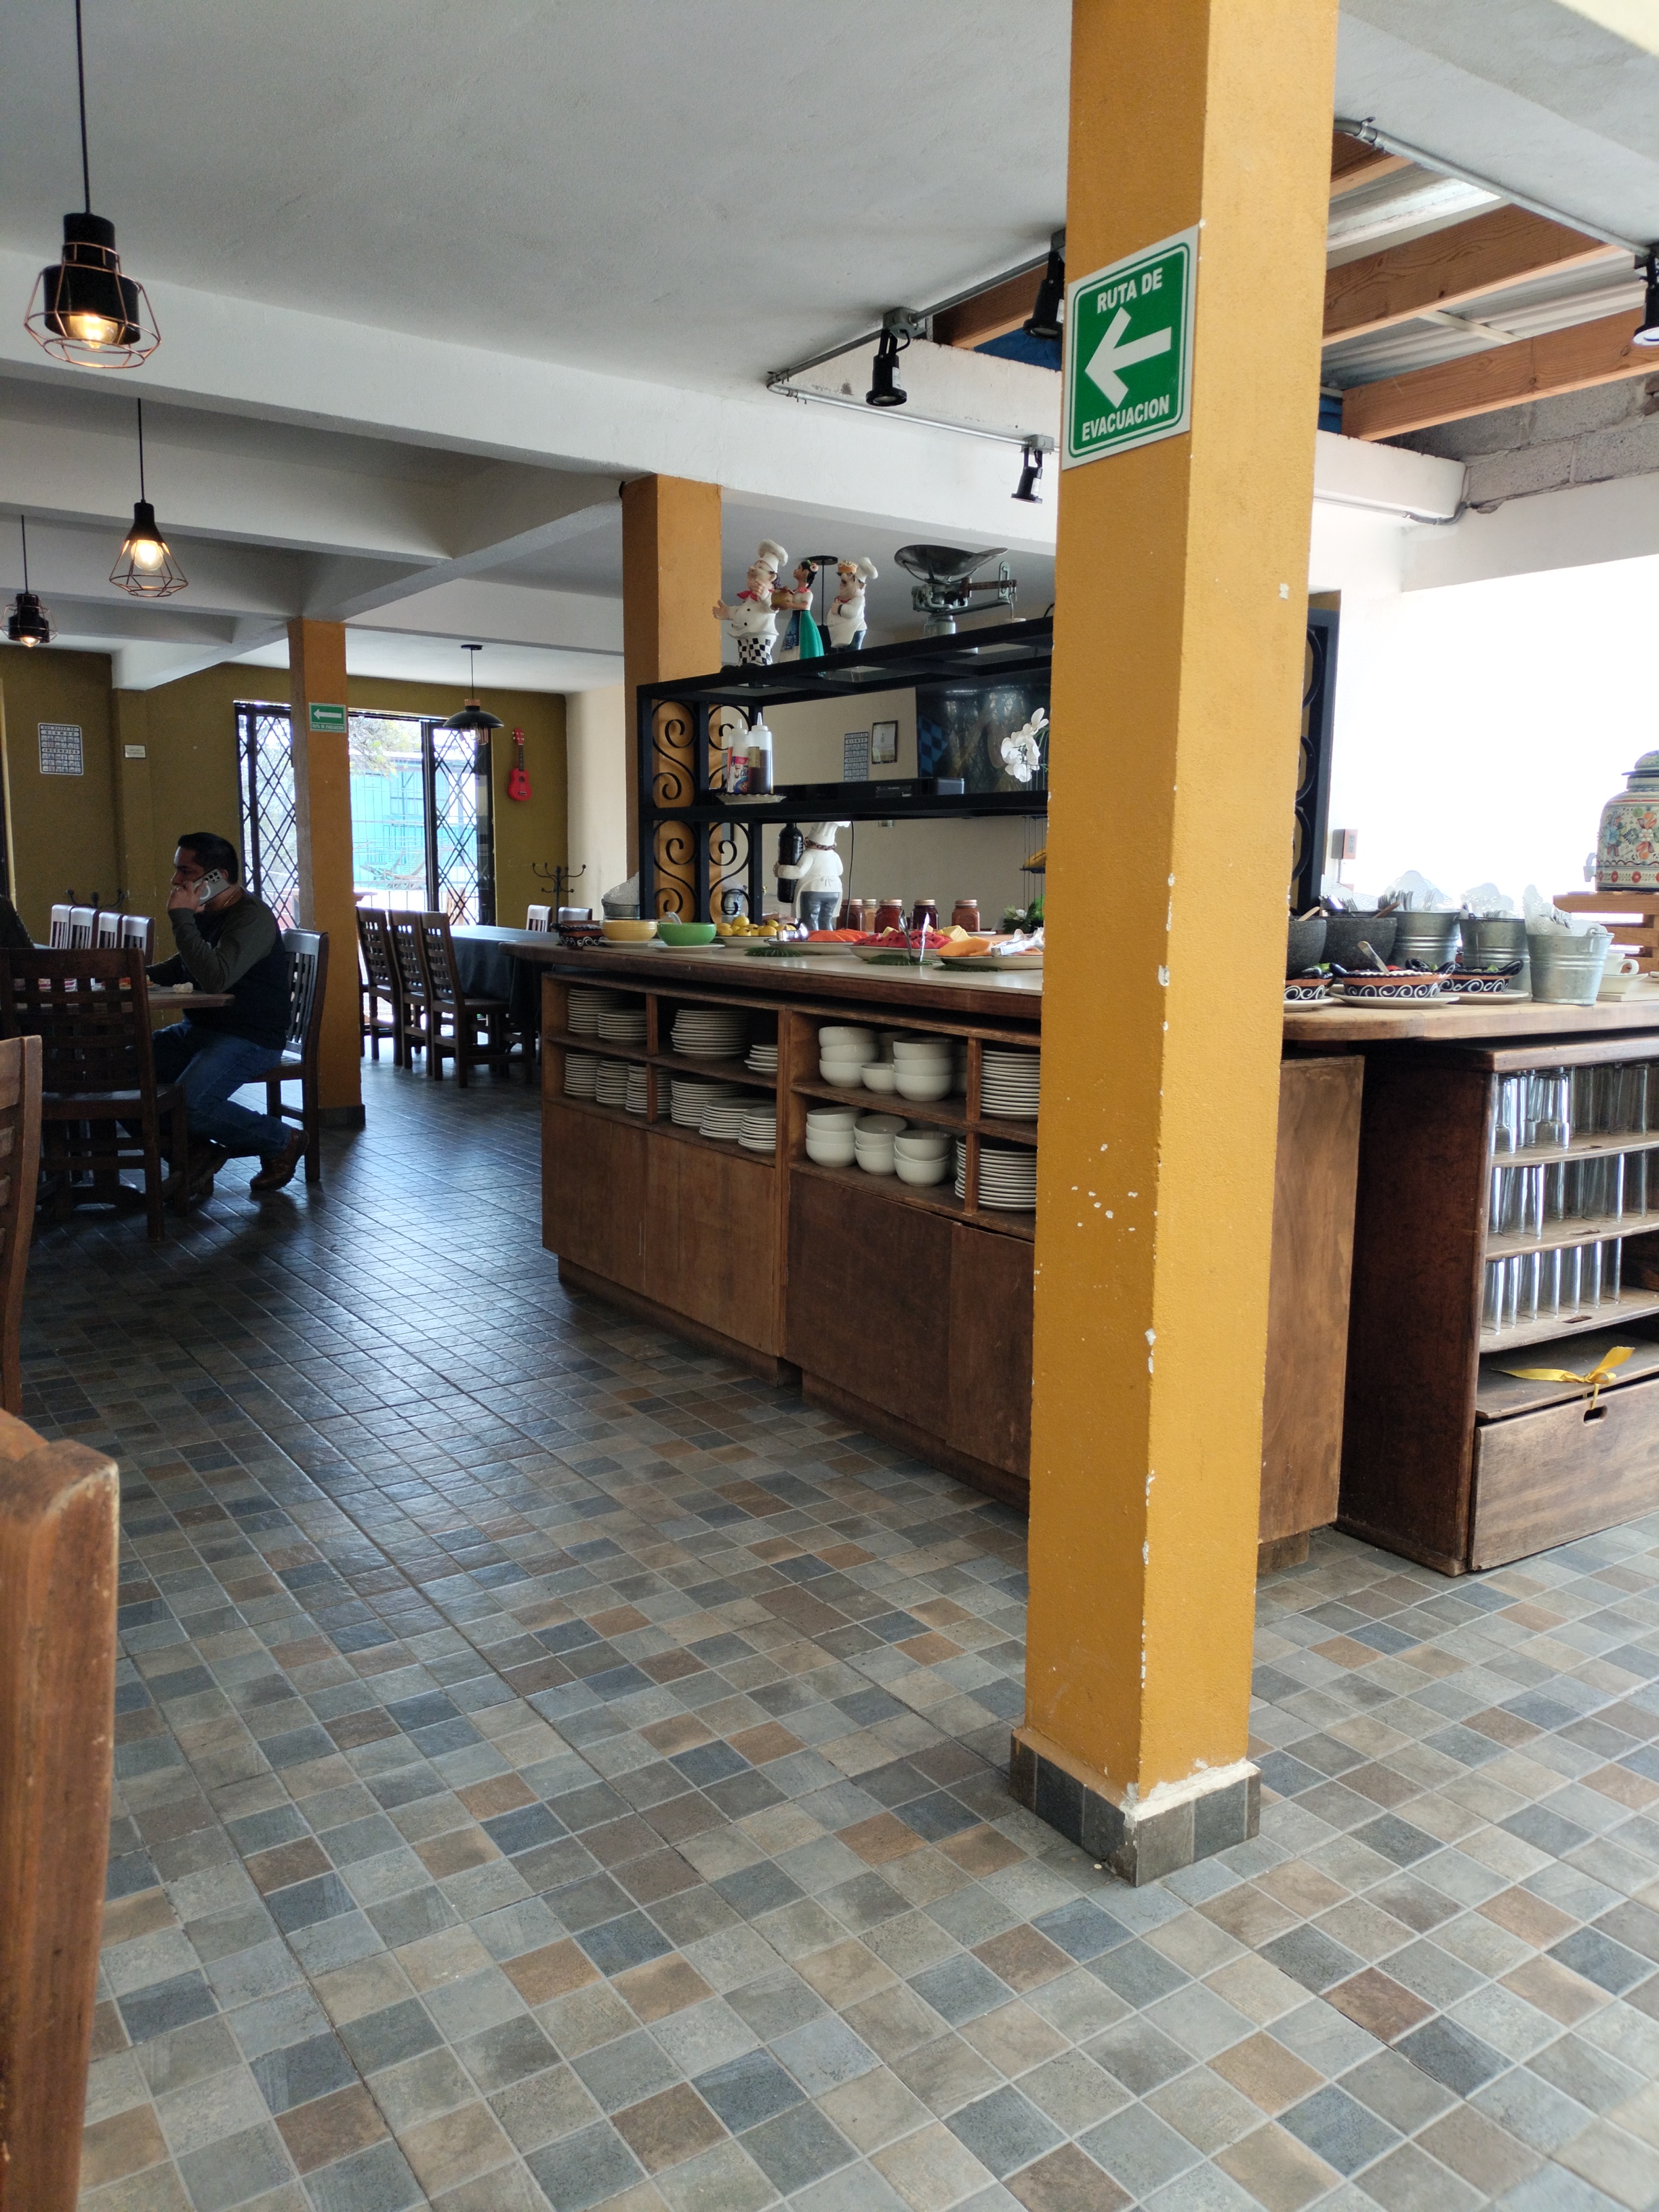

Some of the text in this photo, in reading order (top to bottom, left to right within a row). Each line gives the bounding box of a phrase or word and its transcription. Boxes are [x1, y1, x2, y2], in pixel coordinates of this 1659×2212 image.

[1097, 268, 1163, 314] RUTA DE
[1082, 394, 1170, 441] EVACUACION
